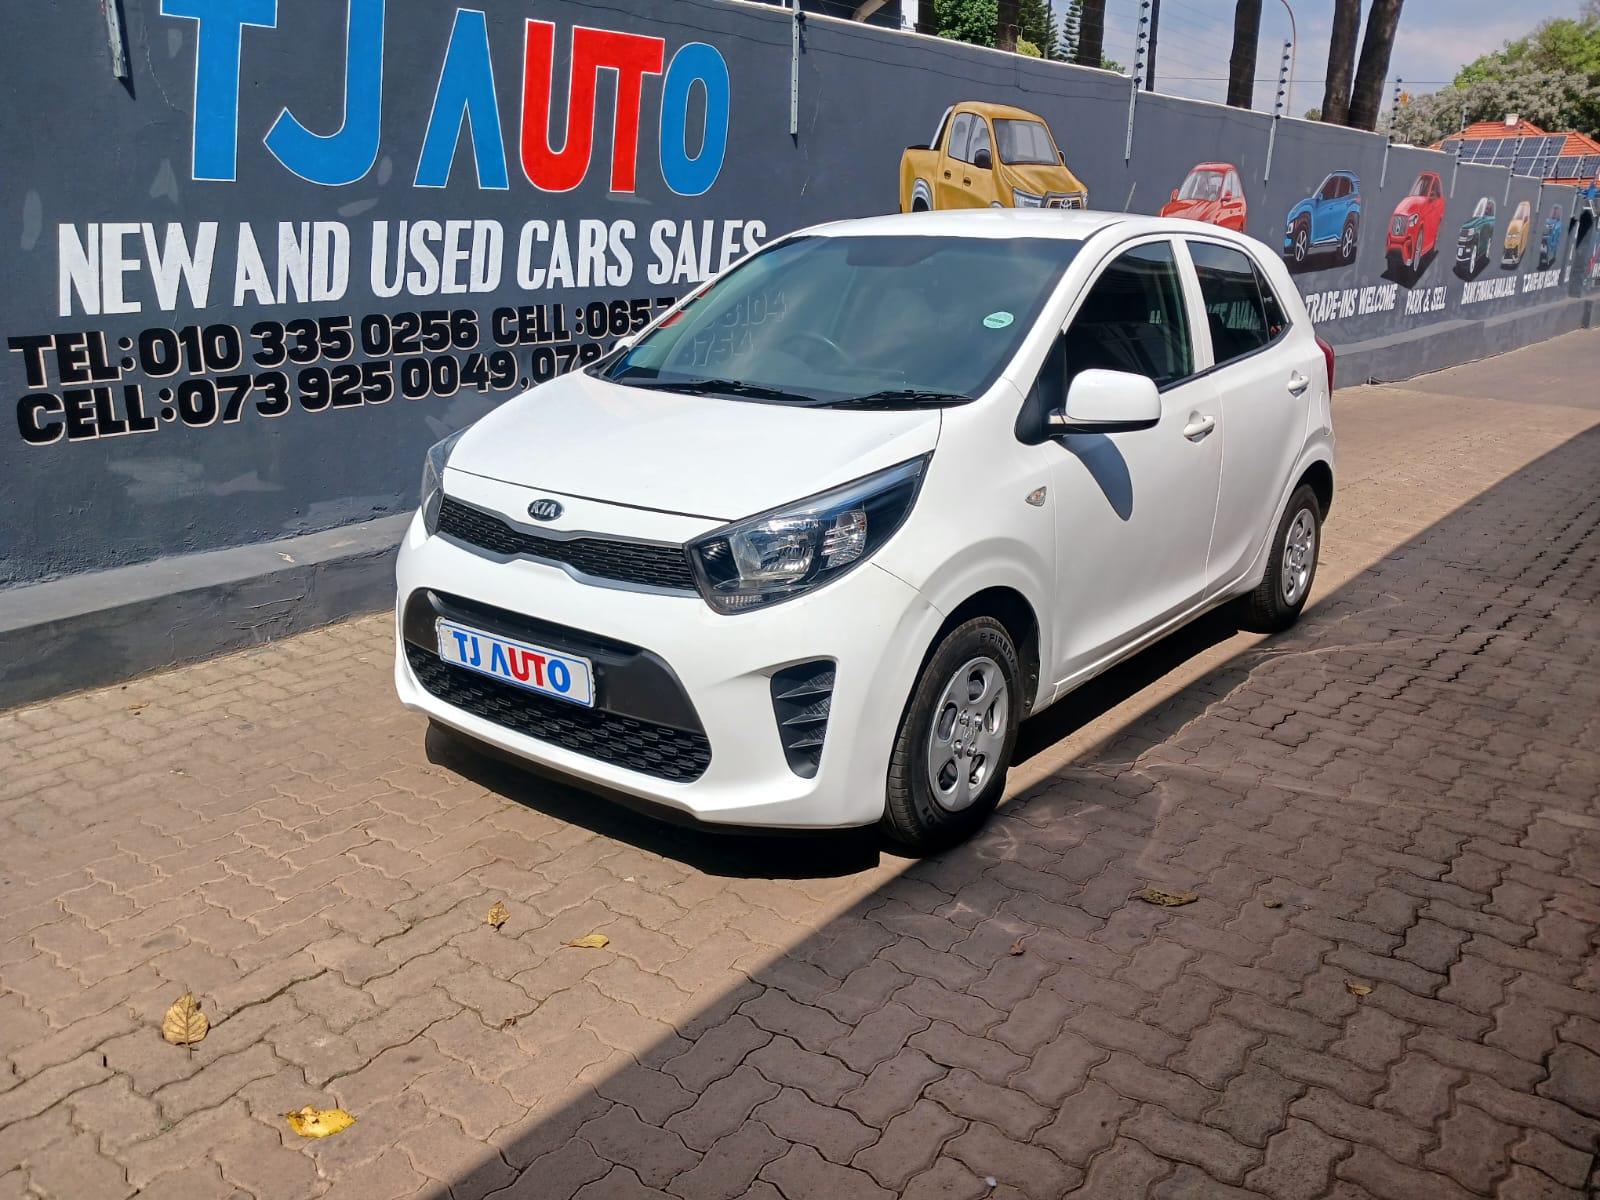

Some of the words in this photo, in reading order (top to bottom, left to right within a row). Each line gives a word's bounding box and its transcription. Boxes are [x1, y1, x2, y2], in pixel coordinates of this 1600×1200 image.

[159, 0, 385, 187] TJ
[413, 7, 730, 197] AUTO
[58, 221, 219, 317] NEW
[233, 221, 350, 307] AND
[370, 219, 503, 299] USED
[517, 219, 636, 291] CARS
[647, 219, 767, 283] SALES
[1305, 288, 1359, 324] TRADE-INS
[1358, 283, 1398, 315] WELCOME
[1404, 289, 1426, 316] PARK
[1431, 286, 1448, 312] SELL
[250, 315, 354, 368] 335
[361, 309, 480, 358] 0256
[298, 360, 395, 413] 925
[530, 502, 556, 517] KIA
[452, 630, 482, 667] TJ
[491, 642, 571, 693] AUTO
